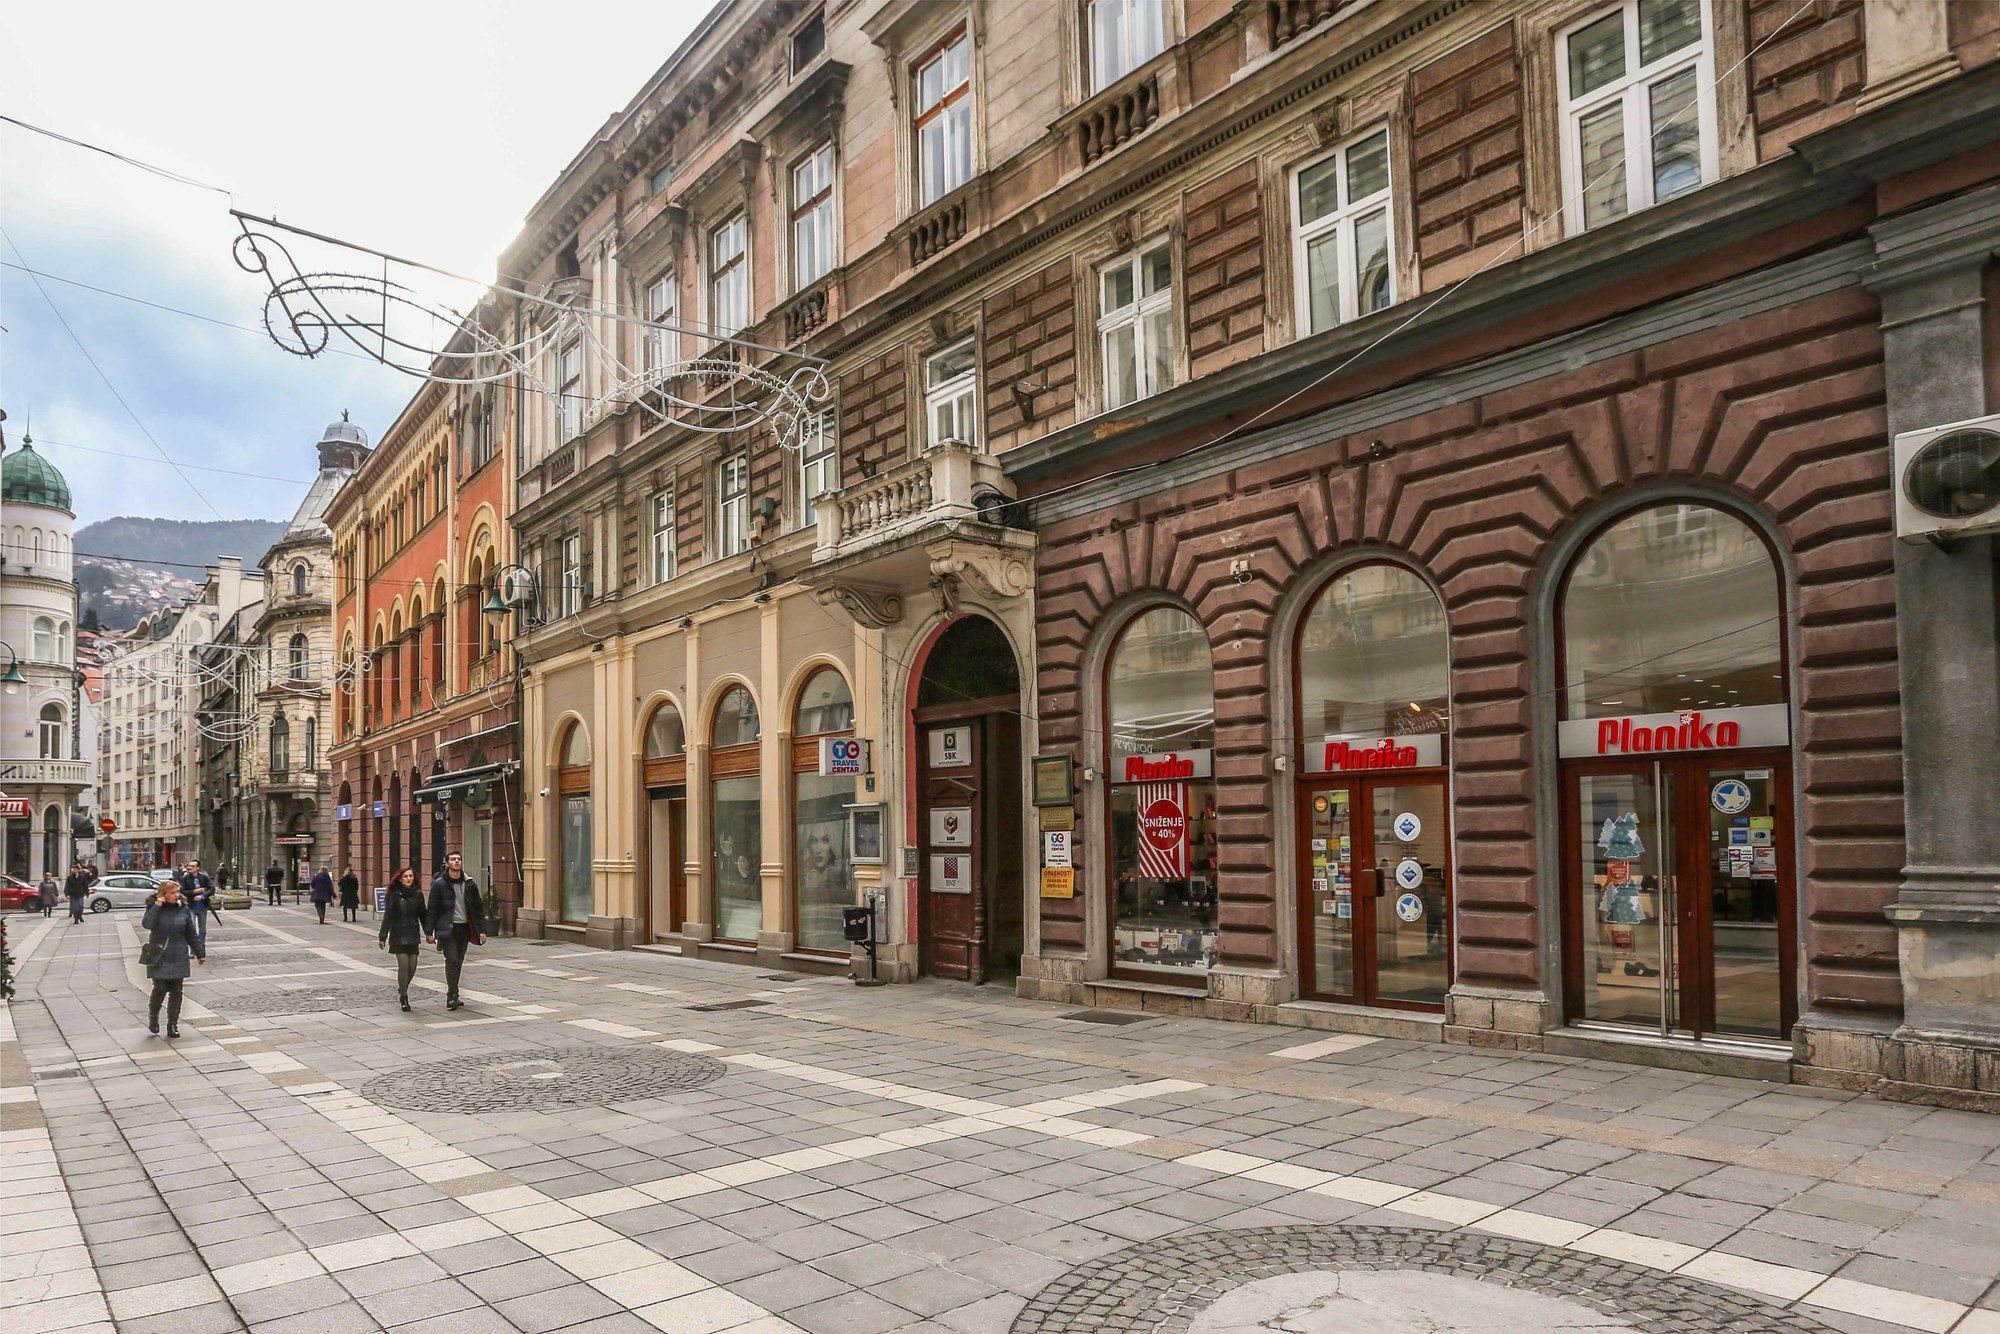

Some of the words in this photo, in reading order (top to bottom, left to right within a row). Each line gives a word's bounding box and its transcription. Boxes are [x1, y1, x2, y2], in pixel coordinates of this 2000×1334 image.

[1597, 711, 1740, 754] Planika
[834, 743, 858, 757] TC
[944, 752, 957, 760] SBK
[1324, 738, 1418, 771] Planika
[1125, 753, 1194, 781] Planika
[1144, 816, 1183, 828] SNIŽENJE
[1158, 829, 1176, 838] 40%
